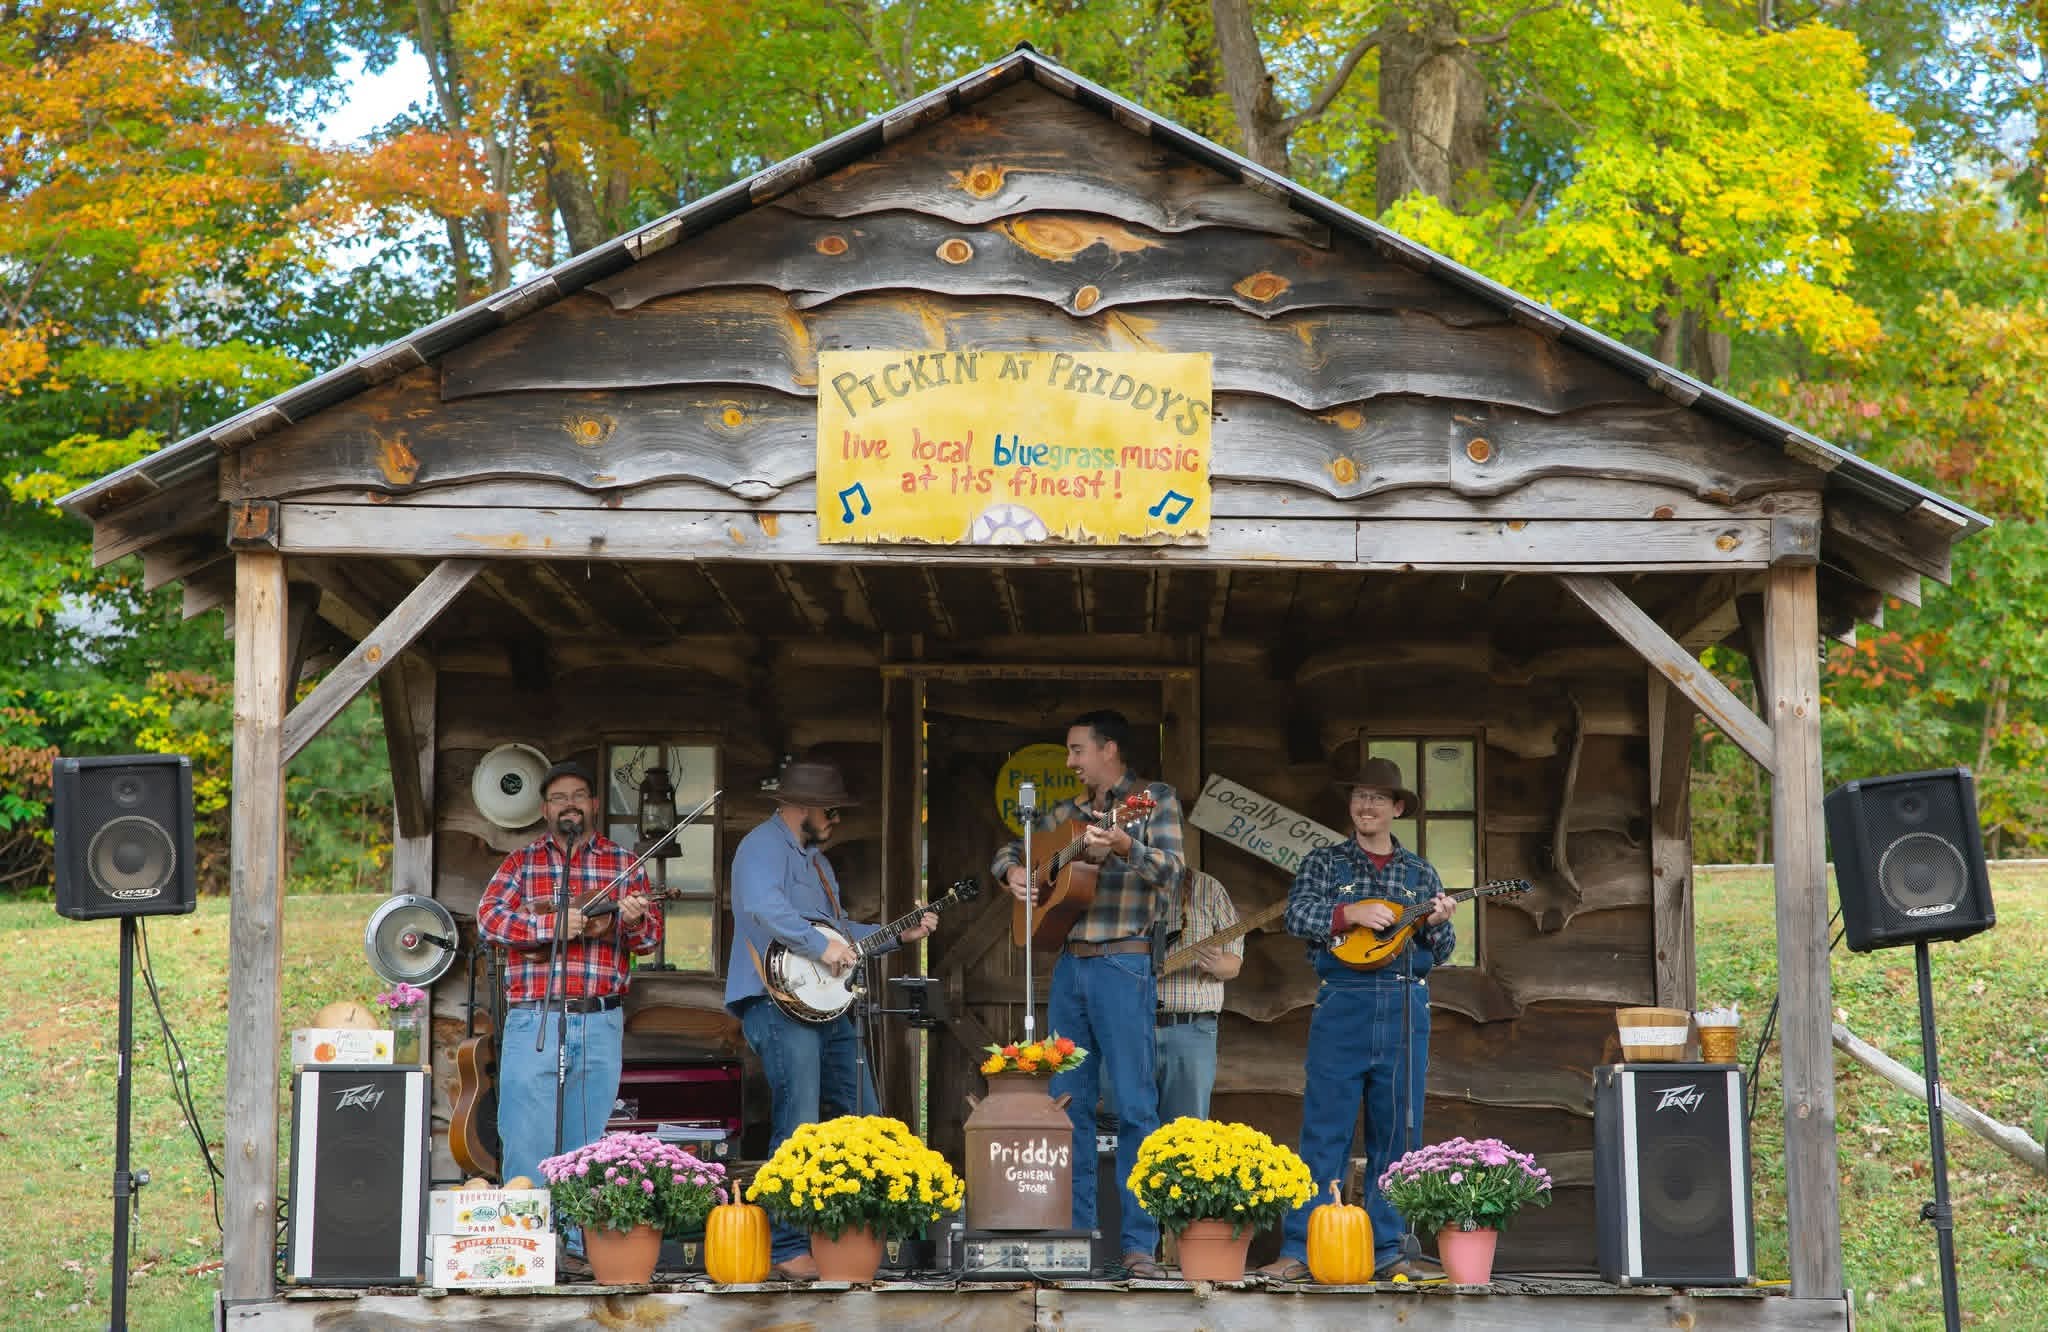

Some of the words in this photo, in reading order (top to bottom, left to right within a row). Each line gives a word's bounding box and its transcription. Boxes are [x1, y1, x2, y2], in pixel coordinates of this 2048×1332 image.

[997, 355, 1034, 381] AT
[842, 429, 891, 461] live
[911, 427, 974, 464] local
[901, 464, 938, 494] at
[1205, 779, 1288, 831] Locally
[1289, 820, 1335, 849] Gro
[331, 1083, 385, 1111] PEAVEY
[1651, 1084, 1705, 1113] PEAVEY
[990, 1138, 1069, 1168] Priddy's
[1005, 1166, 1056, 1181] GENERAL
[1017, 1180, 1048, 1193] STORE
[468, 1225, 495, 1233] FARM
